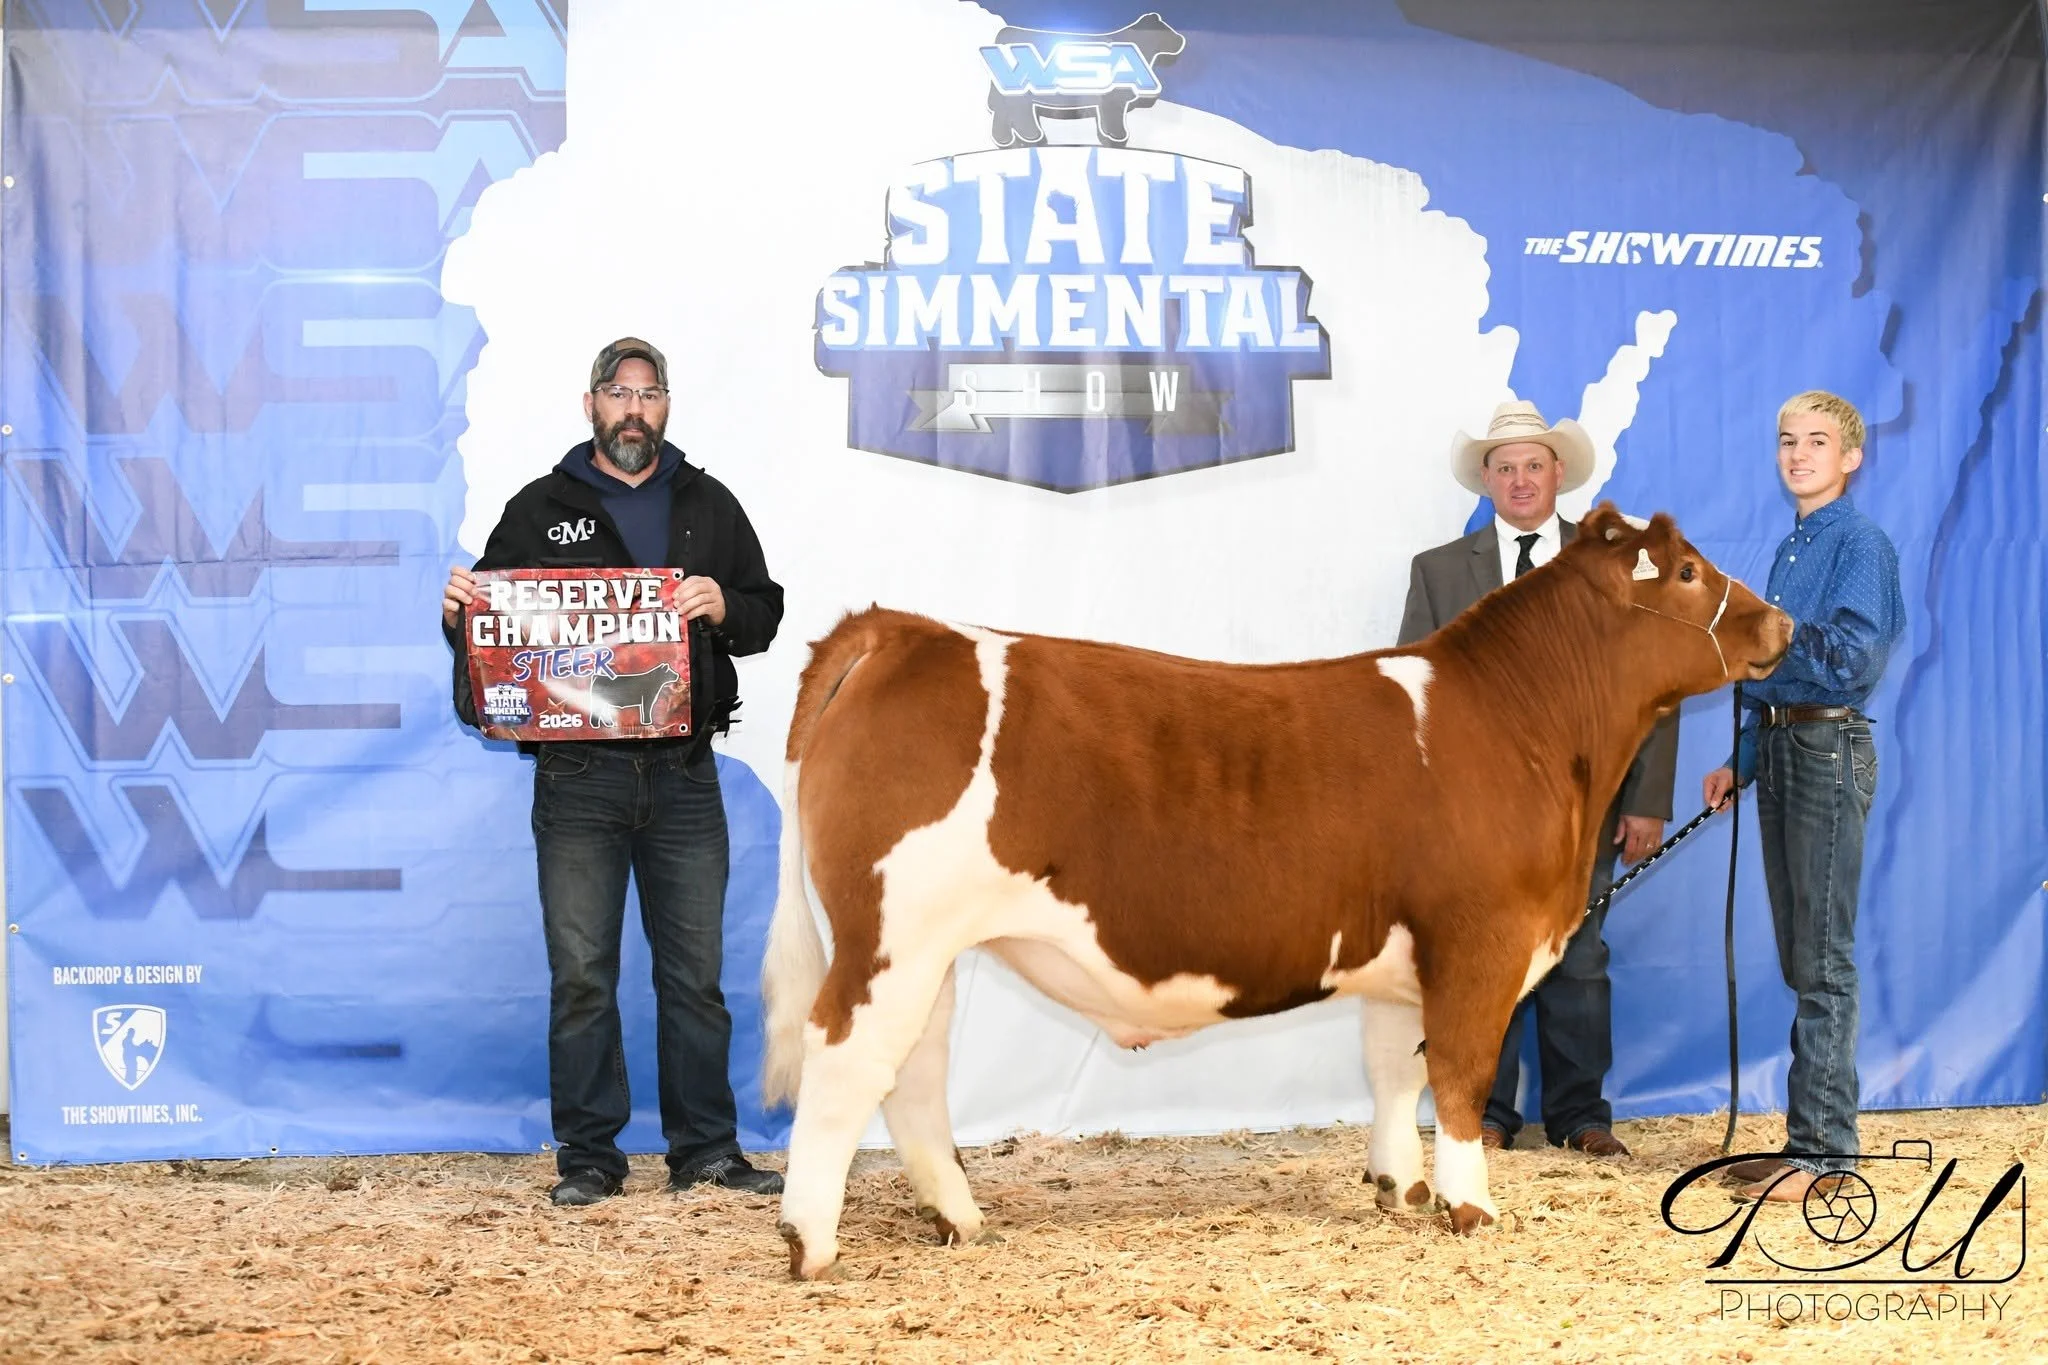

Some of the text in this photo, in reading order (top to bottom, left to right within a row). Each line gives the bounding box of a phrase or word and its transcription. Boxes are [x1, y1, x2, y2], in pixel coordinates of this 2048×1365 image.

[980, 43, 1161, 94] WSA
[888, 147, 1246, 266] STATE
[1524, 230, 1823, 269] THE SHOWTIMES
[822, 273, 1320, 350] SIMMENTAL
[960, 370, 1179, 412] SHOW
[547, 517, 597, 545] CMJ
[489, 578, 664, 612] RESERVE
[472, 610, 682, 647] CHAMPION
[513, 646, 618, 682] STEER
[484, 706, 530, 716] SIMMENTAL
[489, 697, 523, 708] STATE
[539, 713, 583, 729] 2026
[53, 965, 203, 985] BACKDROP & DESIGN BY
[61, 1103, 204, 1126] THE SHOWTIMES, INC.
